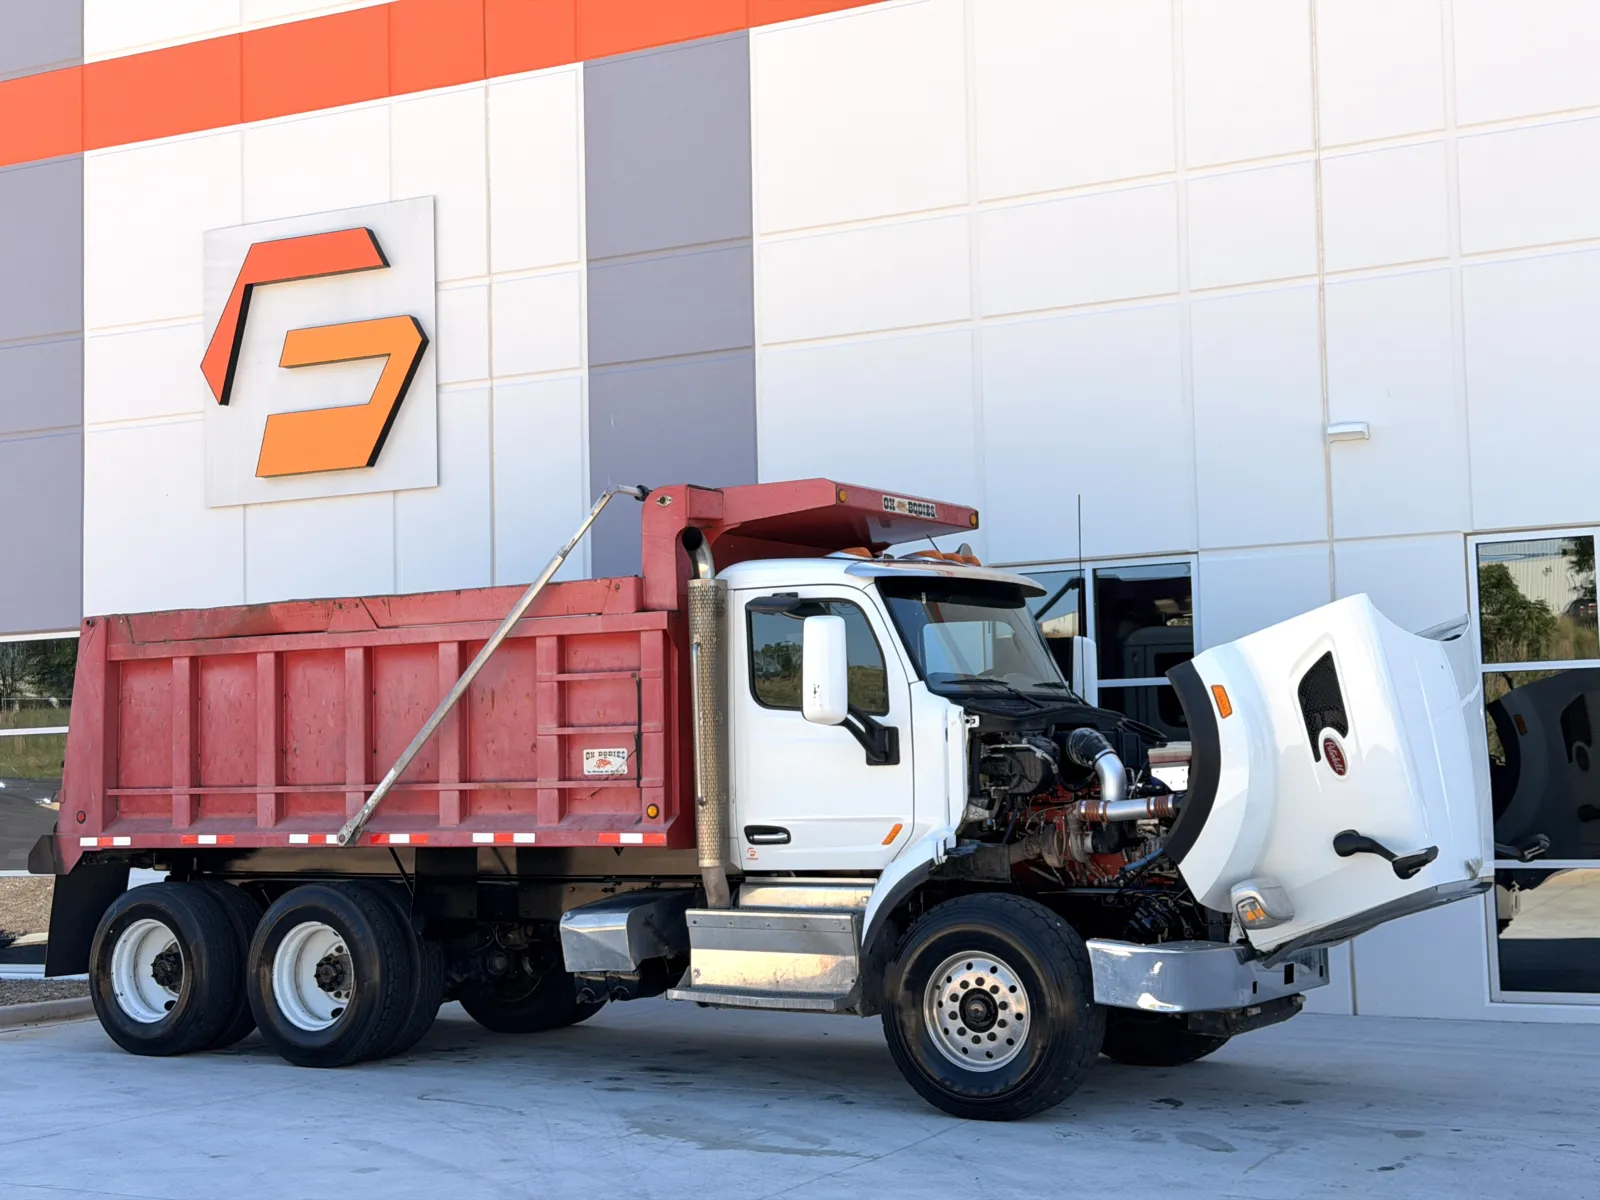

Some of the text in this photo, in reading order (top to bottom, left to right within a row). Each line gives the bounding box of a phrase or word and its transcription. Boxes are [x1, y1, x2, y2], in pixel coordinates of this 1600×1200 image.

[883, 497, 937, 518] OX BODIES
[585, 751, 626, 760] OX BODIES
